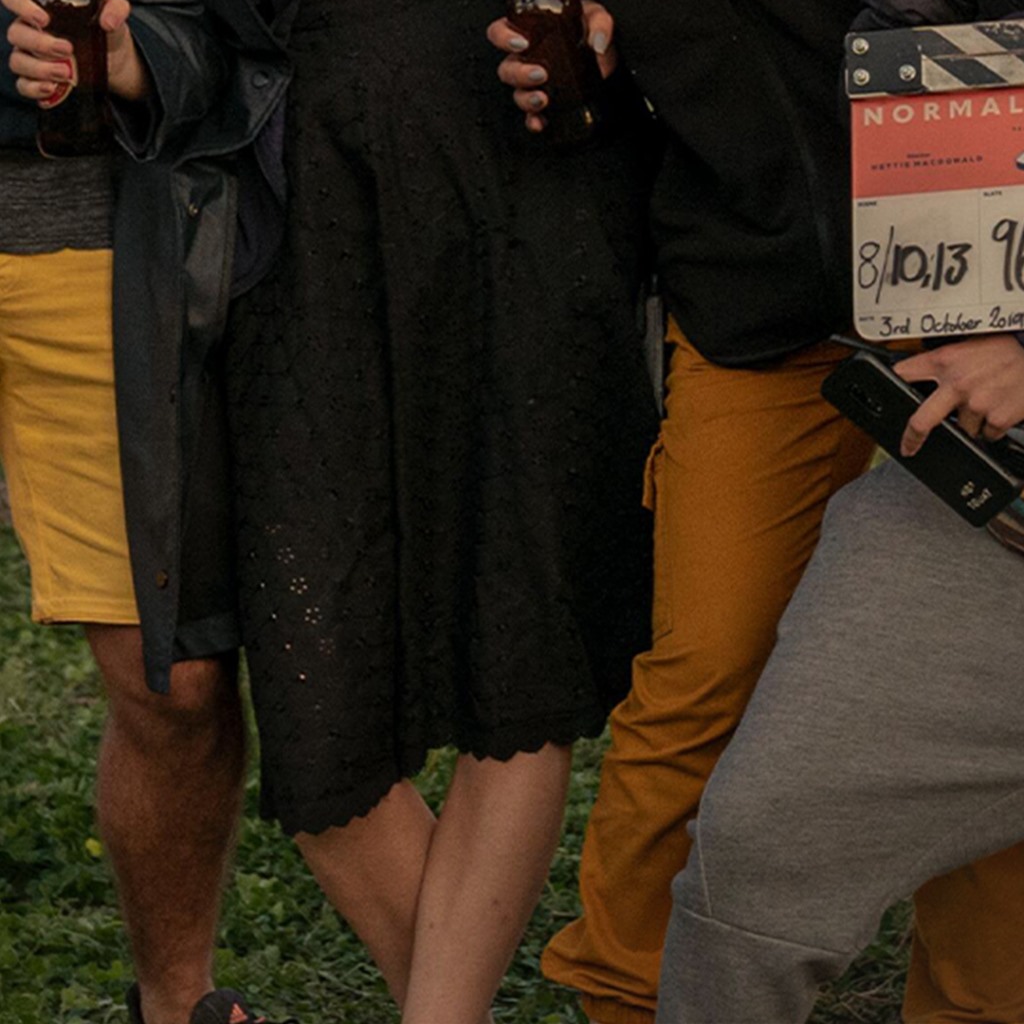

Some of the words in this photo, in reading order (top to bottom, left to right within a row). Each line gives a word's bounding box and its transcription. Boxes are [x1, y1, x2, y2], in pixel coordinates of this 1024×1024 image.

[864, 95, 1024, 126] NORMAL
[879, 316, 911, 337] 3rd
[921, 313, 982, 333] October
